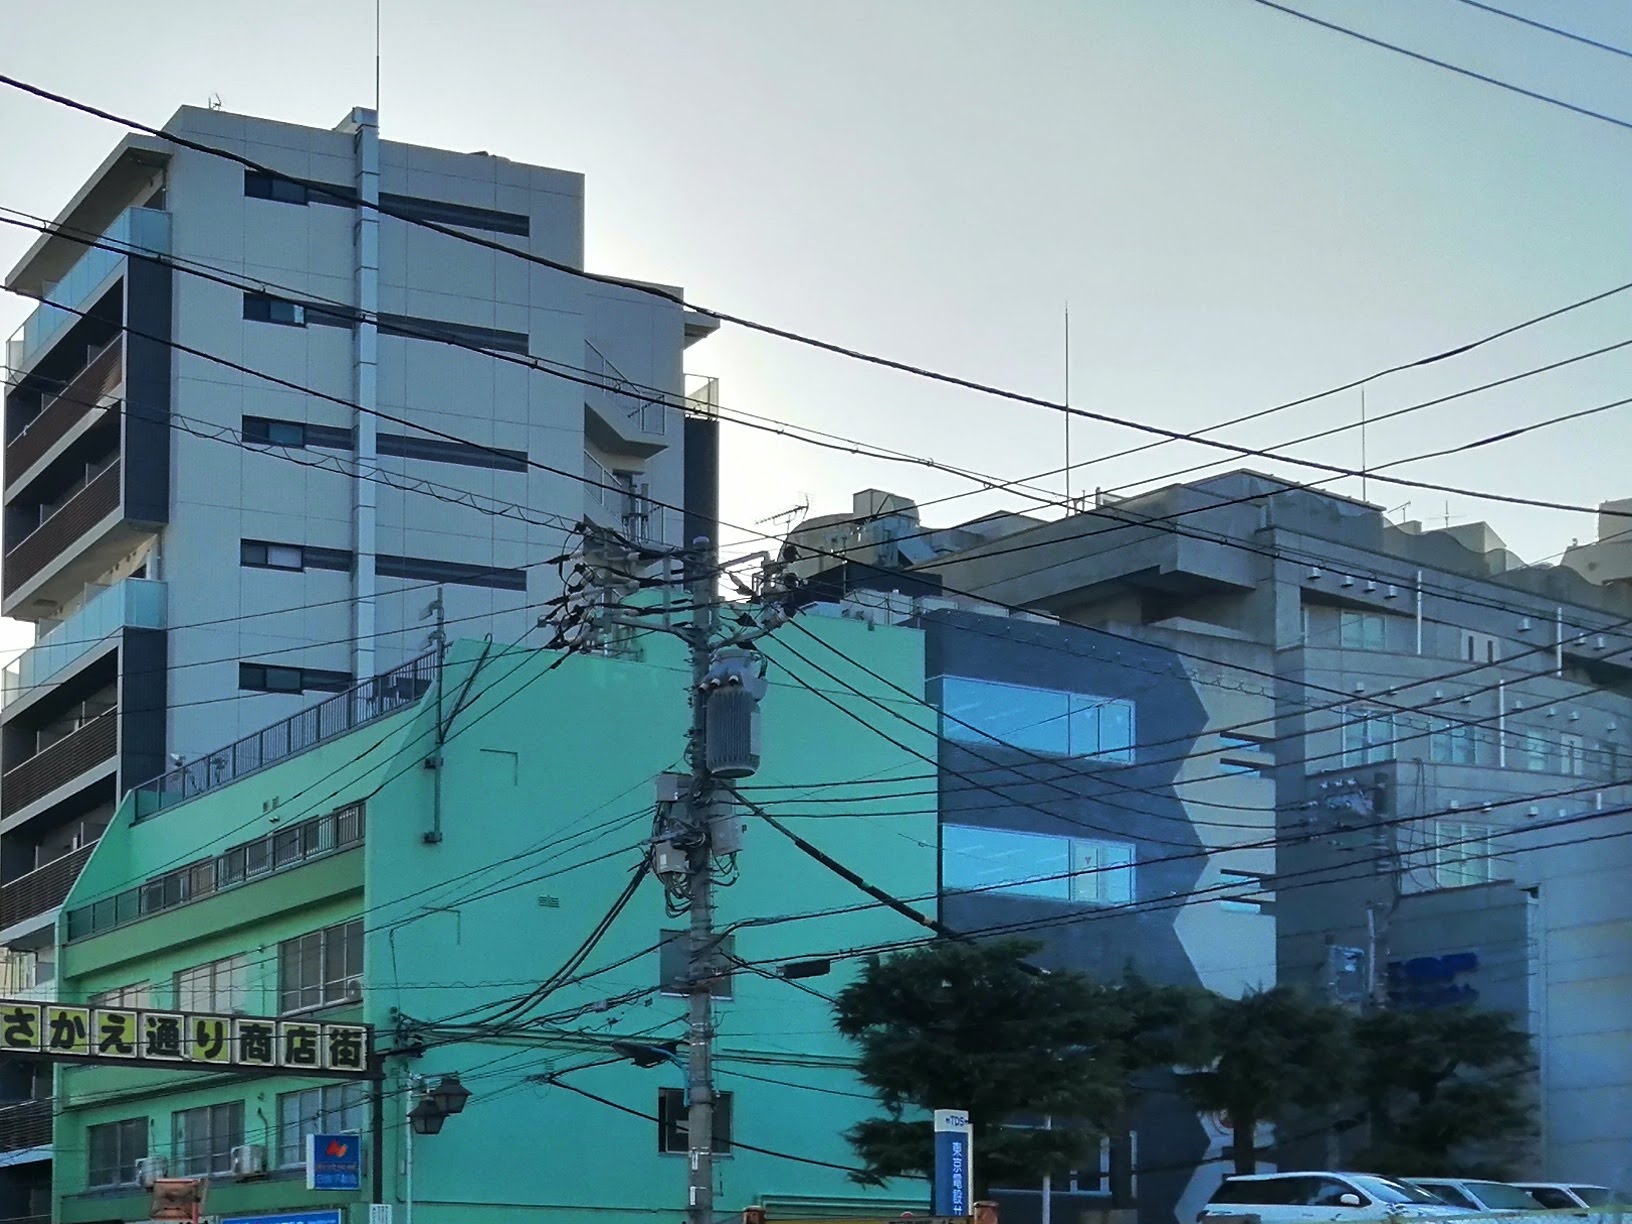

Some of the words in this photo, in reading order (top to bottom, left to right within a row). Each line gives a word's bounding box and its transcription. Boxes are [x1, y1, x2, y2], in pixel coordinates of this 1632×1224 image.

[4, 1007, 362, 1068] さかえ通り商店街
